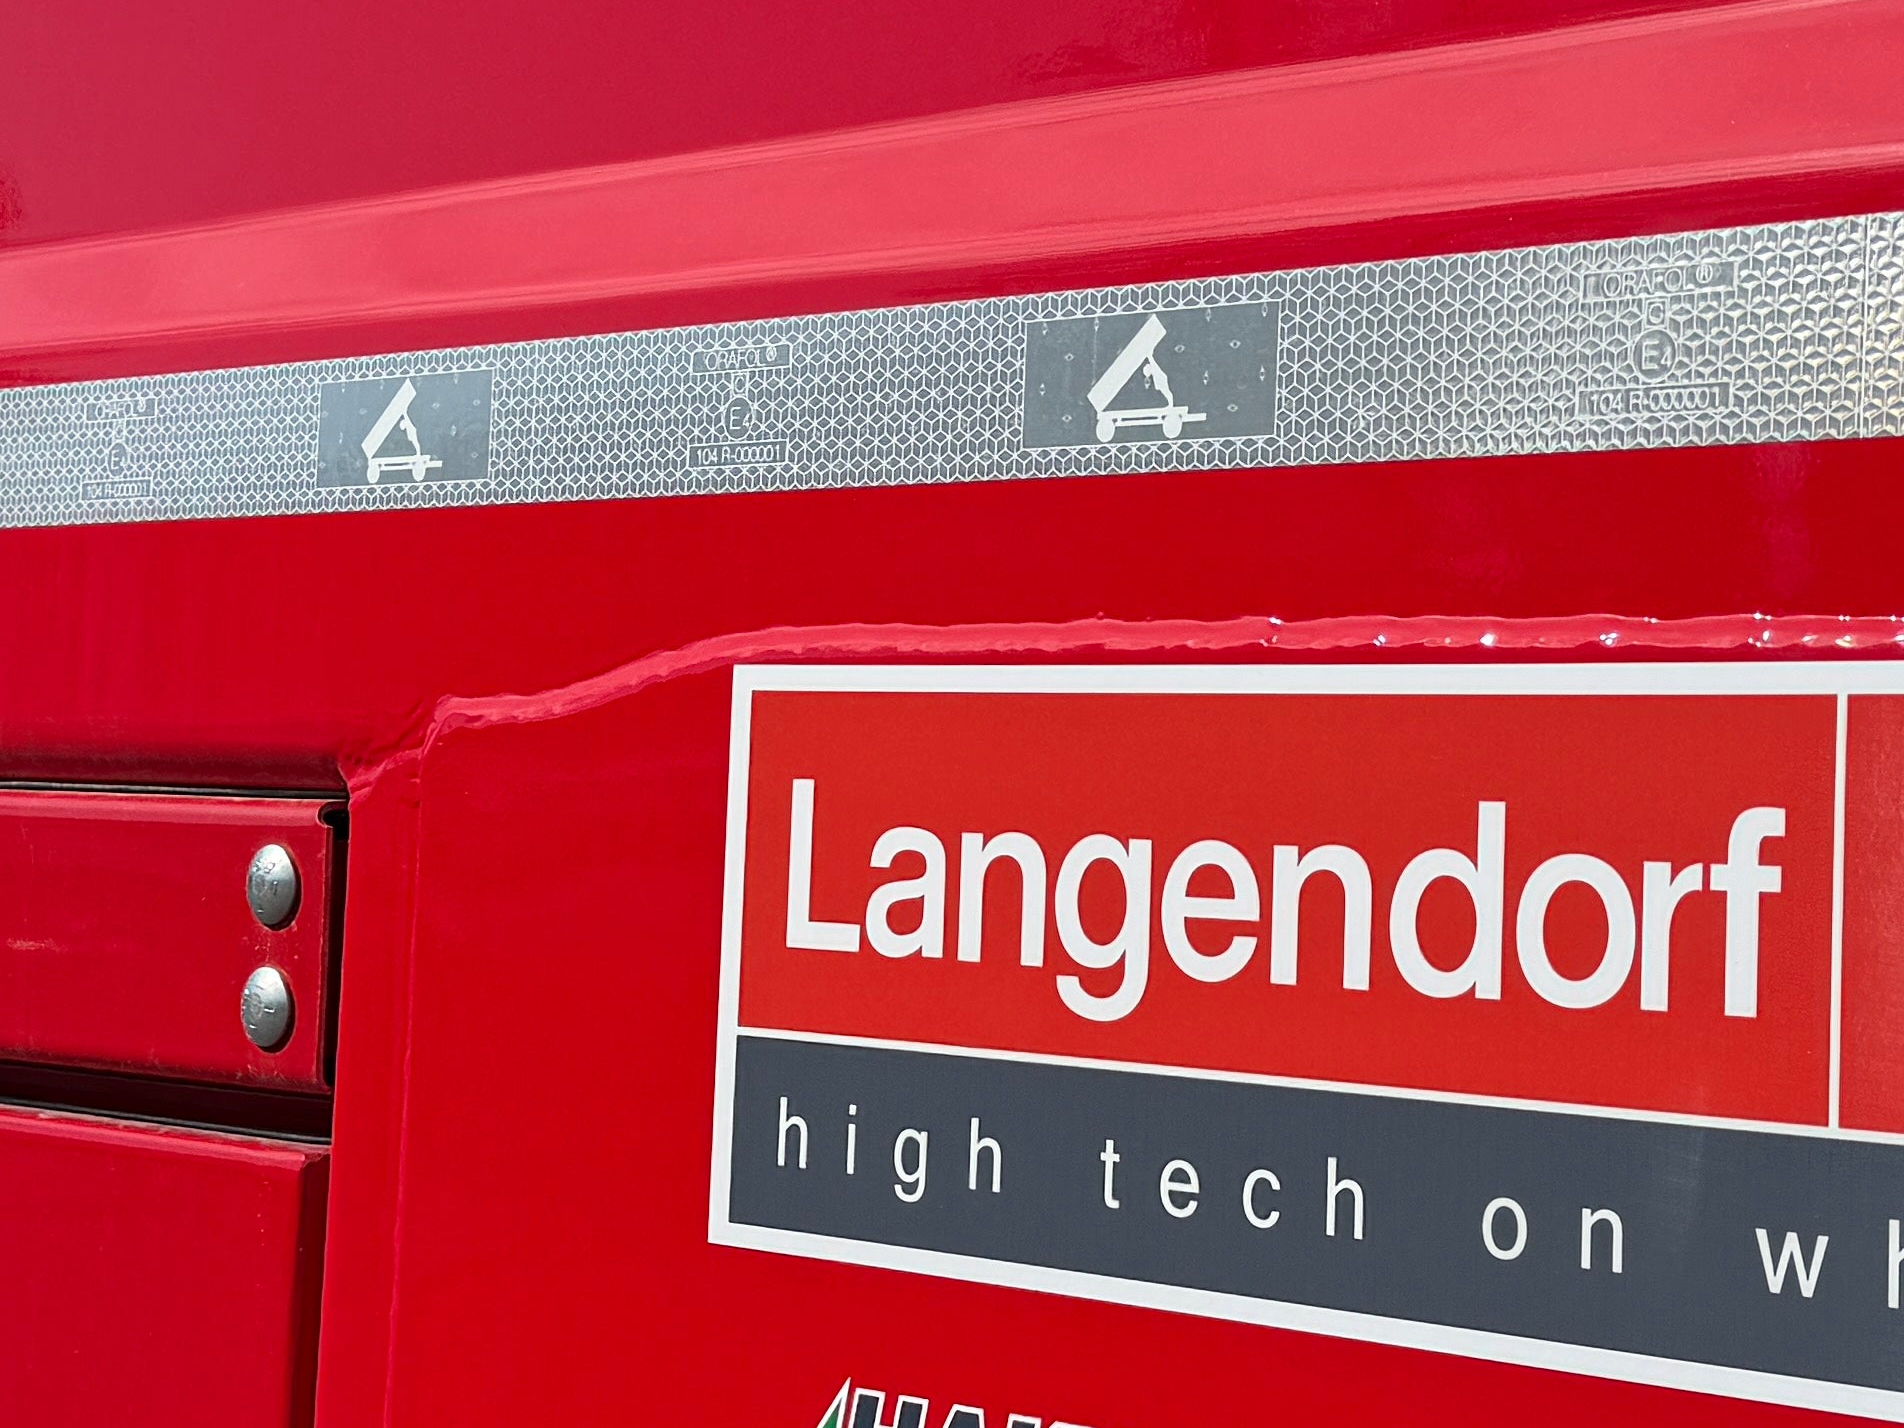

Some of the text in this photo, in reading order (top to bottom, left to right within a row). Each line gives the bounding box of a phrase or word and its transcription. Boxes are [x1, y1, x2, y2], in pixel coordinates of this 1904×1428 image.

[785, 777, 1787, 1023] Langendorf
[776, 1095, 1003, 1205] high
[1099, 1138, 1365, 1242] tech
[1480, 1196, 1624, 1275] on
